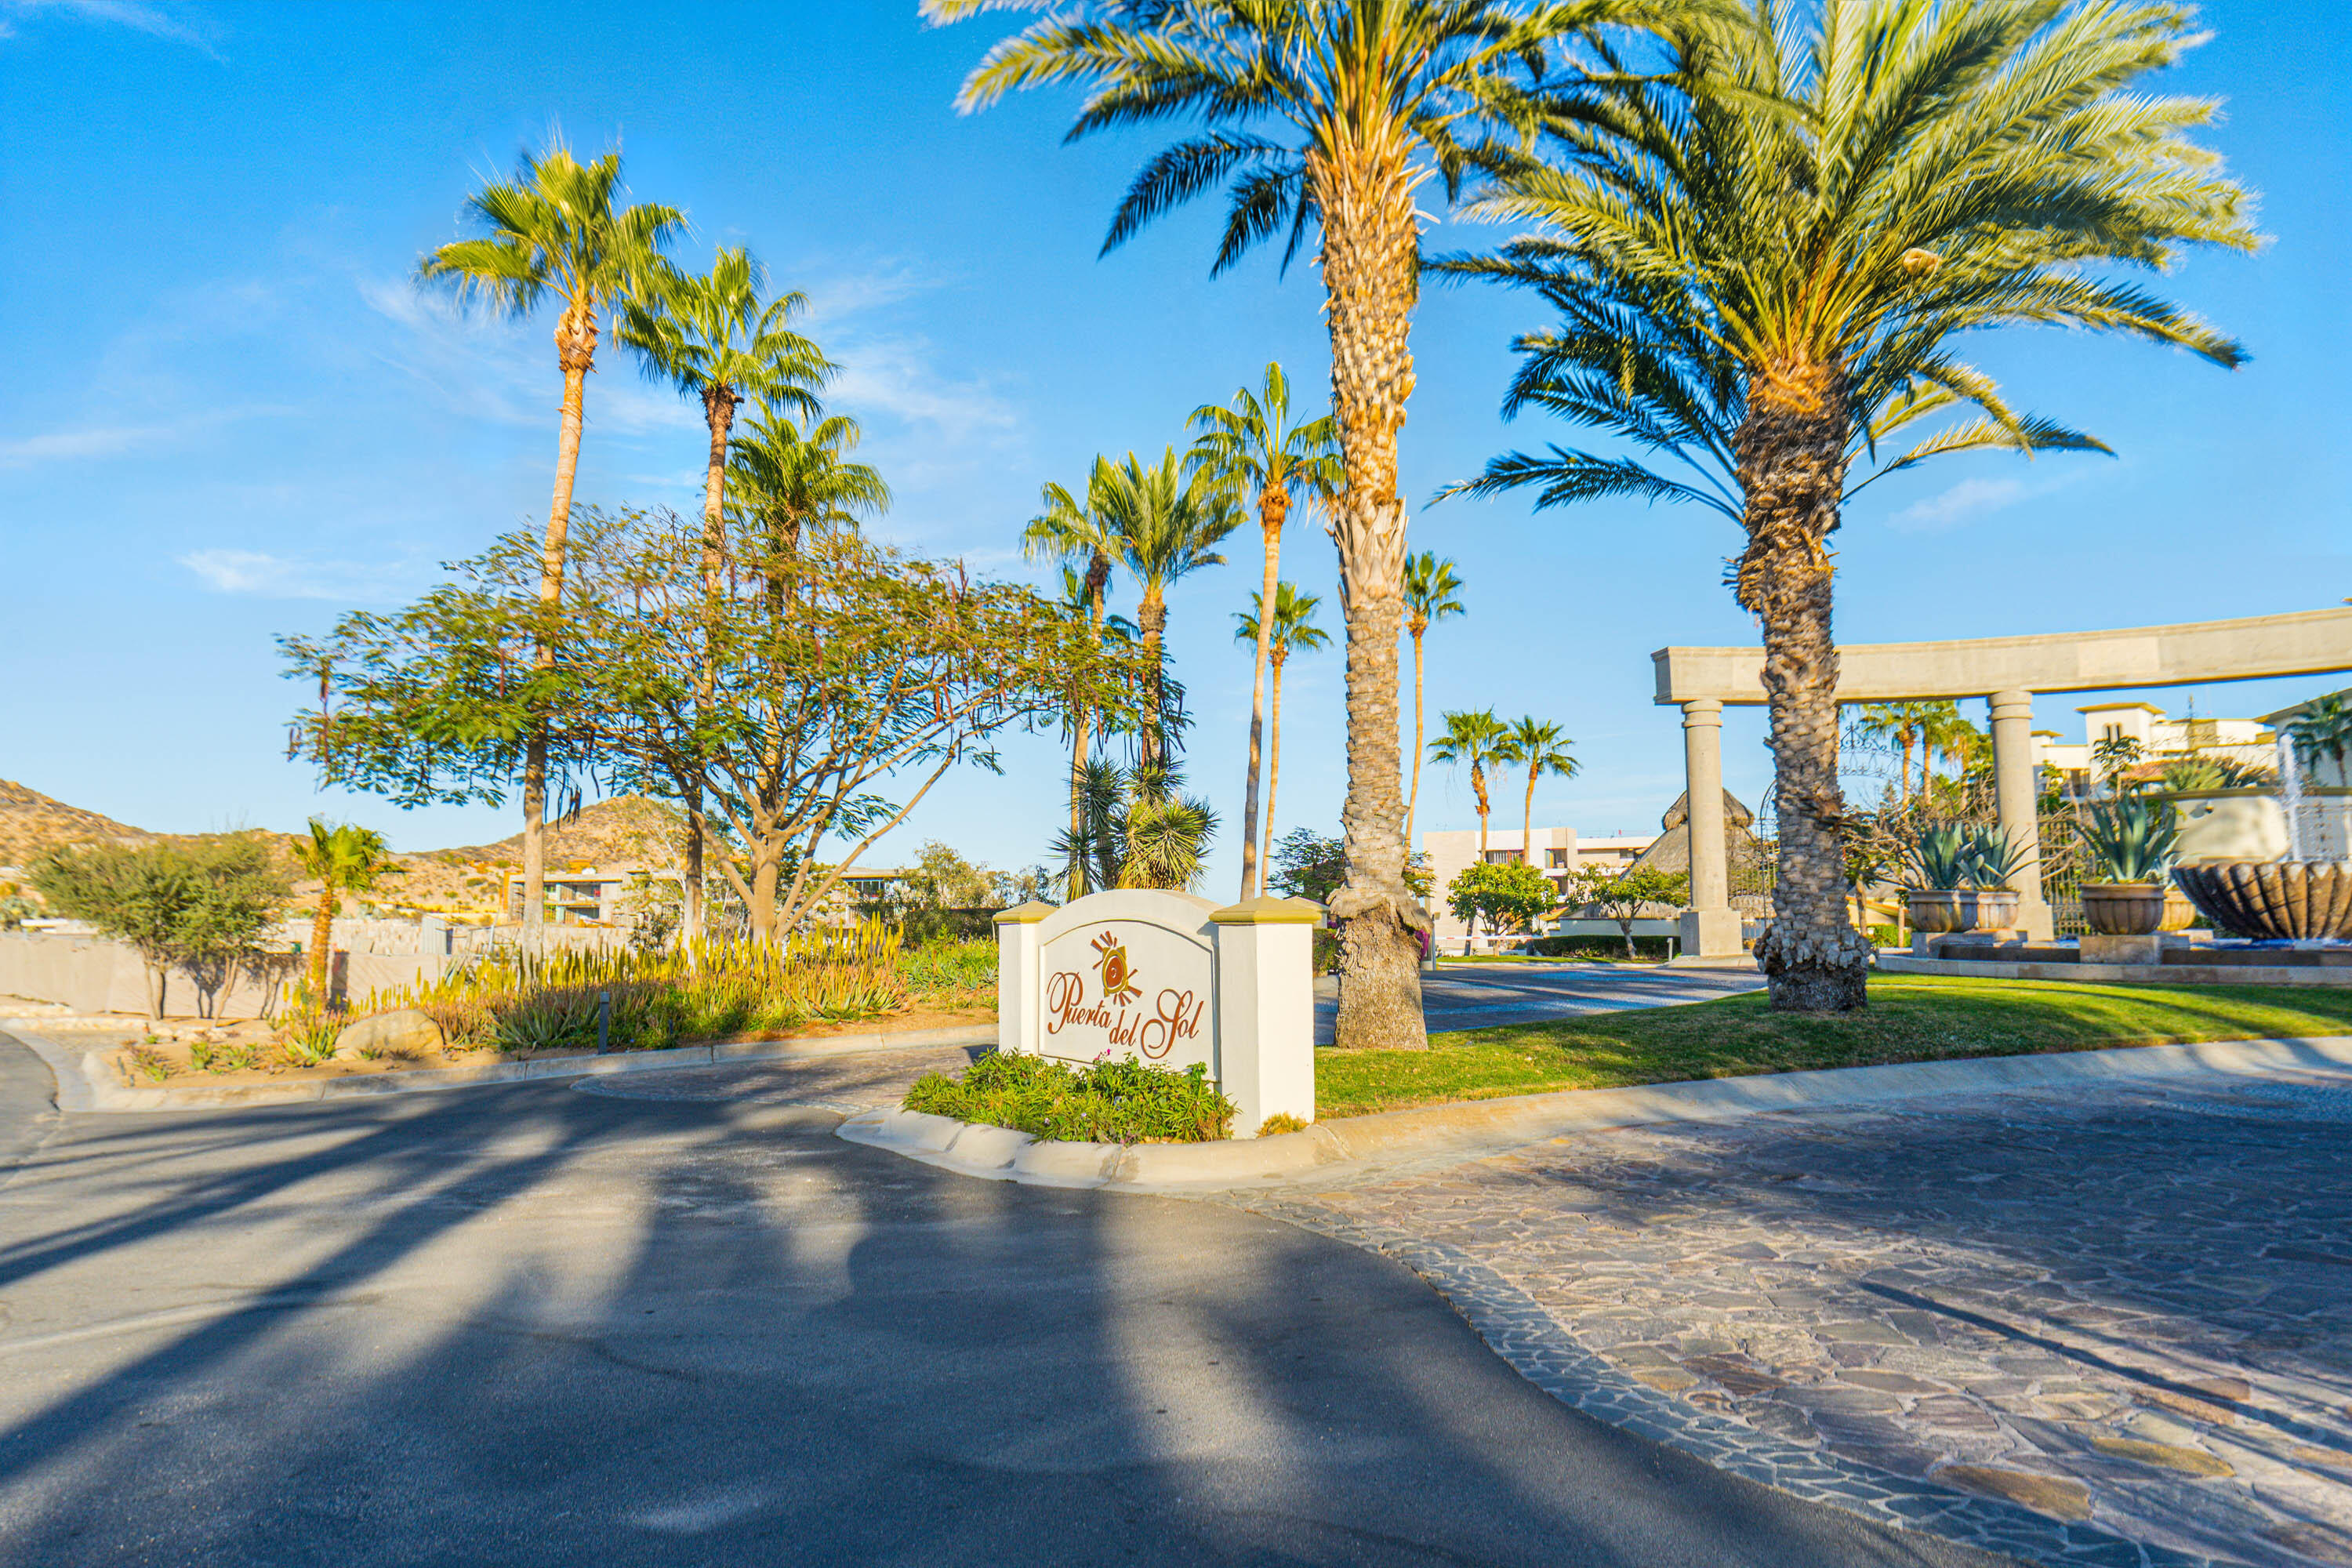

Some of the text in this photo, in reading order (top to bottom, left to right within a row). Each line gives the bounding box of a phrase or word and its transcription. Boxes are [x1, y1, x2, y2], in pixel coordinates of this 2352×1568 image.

[1047, 971, 1205, 1059] Puerta del Sol
